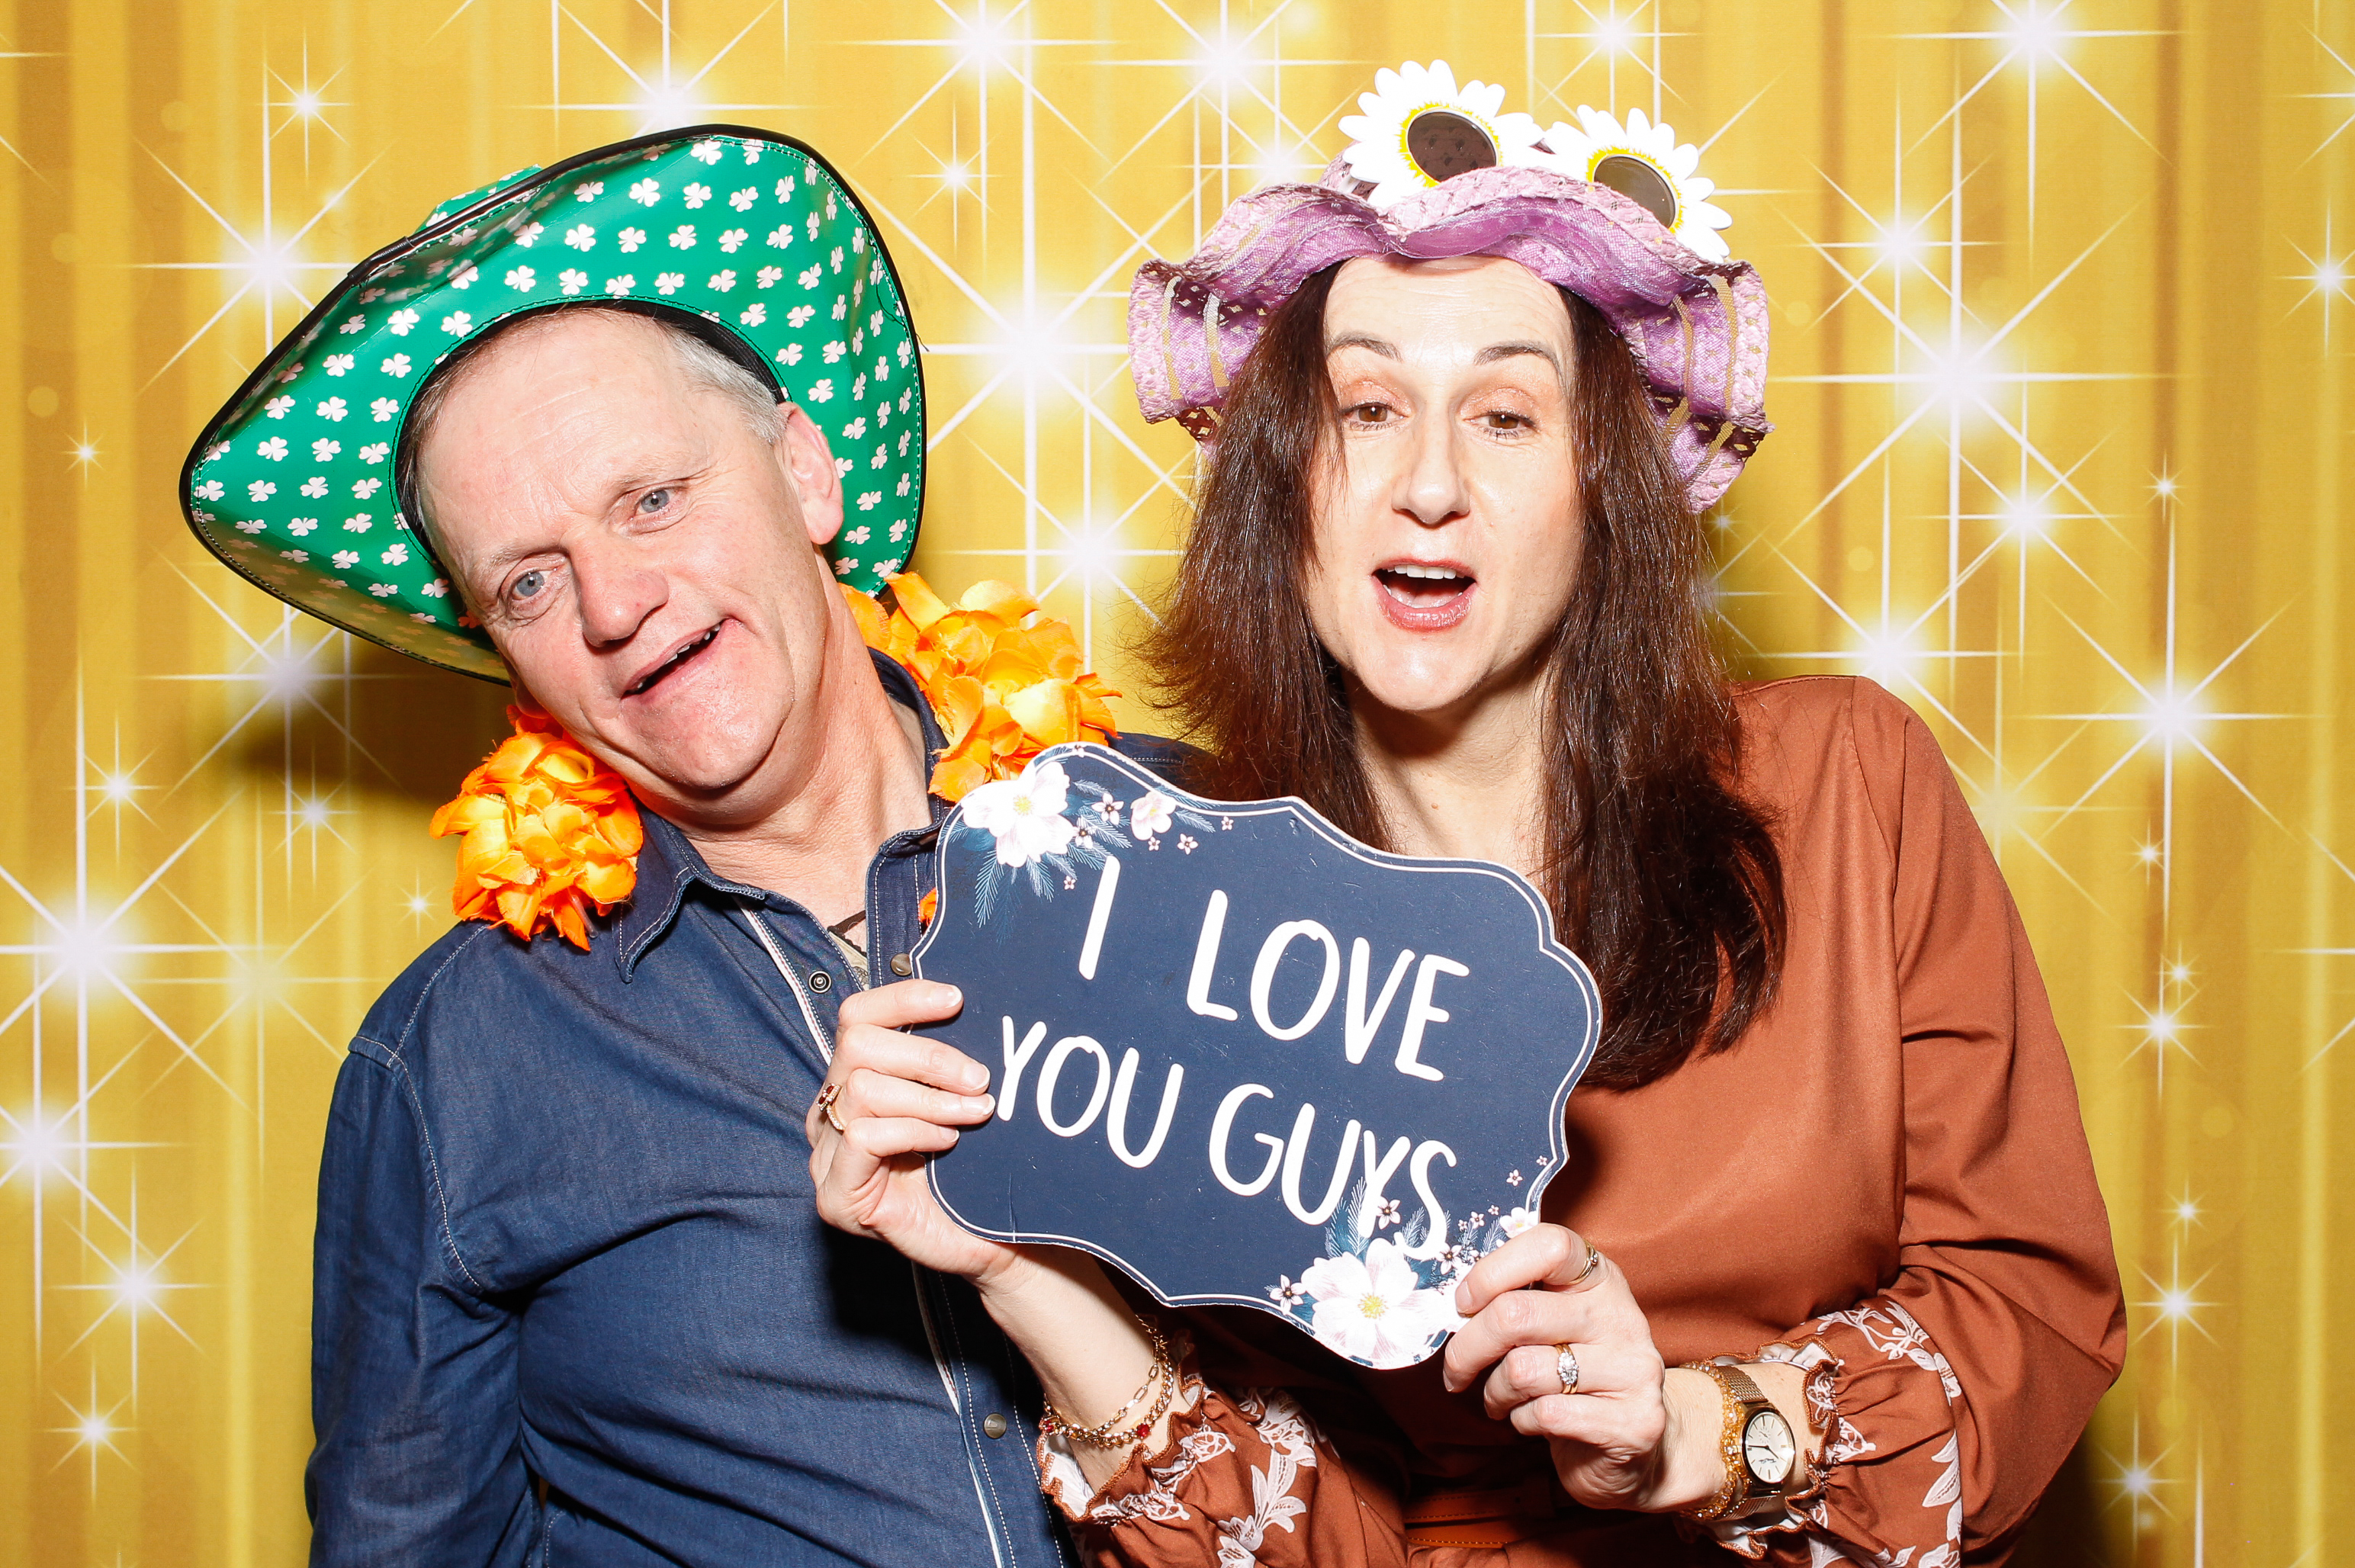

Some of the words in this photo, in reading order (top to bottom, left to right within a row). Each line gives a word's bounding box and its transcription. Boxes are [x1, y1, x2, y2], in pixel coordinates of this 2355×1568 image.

[1078, 855, 1121, 981] I
[1187, 889, 1470, 1081] LOVE
[996, 1015, 1184, 1168] YOU
[1210, 1083, 1457, 1261] GUYS
